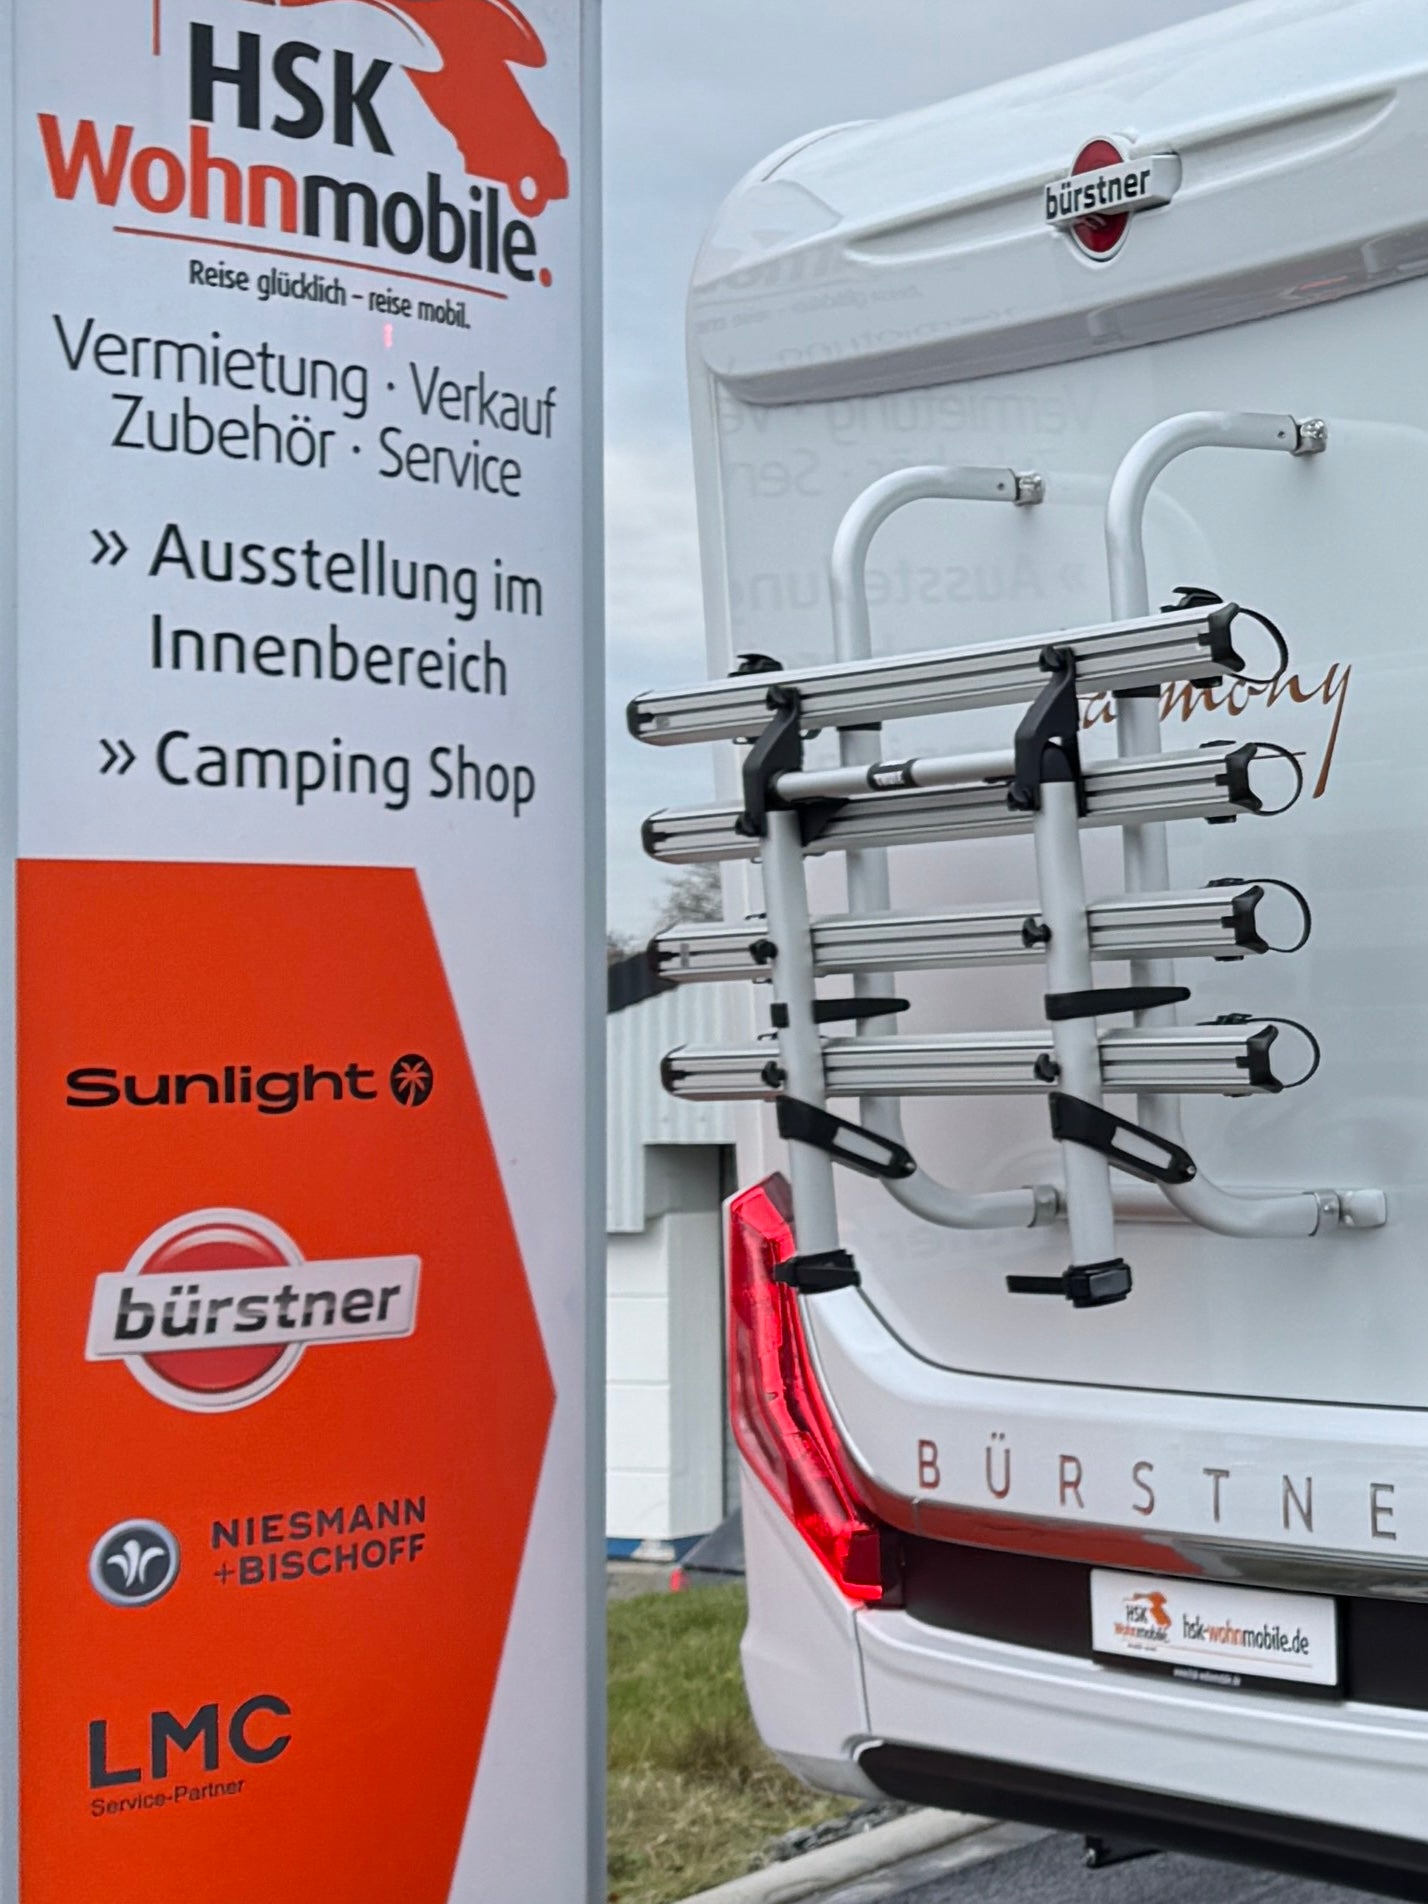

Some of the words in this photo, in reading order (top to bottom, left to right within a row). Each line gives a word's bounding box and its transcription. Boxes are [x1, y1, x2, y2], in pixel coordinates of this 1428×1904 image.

[190, 22, 394, 156] HSK
[1046, 169, 1150, 220] bürstner
[189, 260, 249, 292] Reise
[257, 268, 346, 306] glücklich
[368, 288, 411, 320] reise
[418, 300, 470, 329] mobil.
[52, 314, 368, 418] Vermietung
[410, 362, 557, 439] Verkauf
[111, 393, 335, 468] Zubehör
[379, 426, 522, 497] Service
[148, 523, 477, 621] Ausstellung
[494, 558, 543, 616] im
[151, 614, 507, 696] Innenbereich
[156, 730, 409, 810] Camping
[430, 744, 535, 817] Shop
[66, 1062, 377, 1115] Sunlight
[113, 1282, 402, 1340] bürstner
[211, 1497, 426, 1549] NIESMANN
[1125, 1603, 1149, 1623] HSK
[1182, 1613, 1309, 1655] hsk-wohnmobile.de
[89, 1694, 291, 1790] LMC
[91, 1778, 244, 1817] Service-Partner
